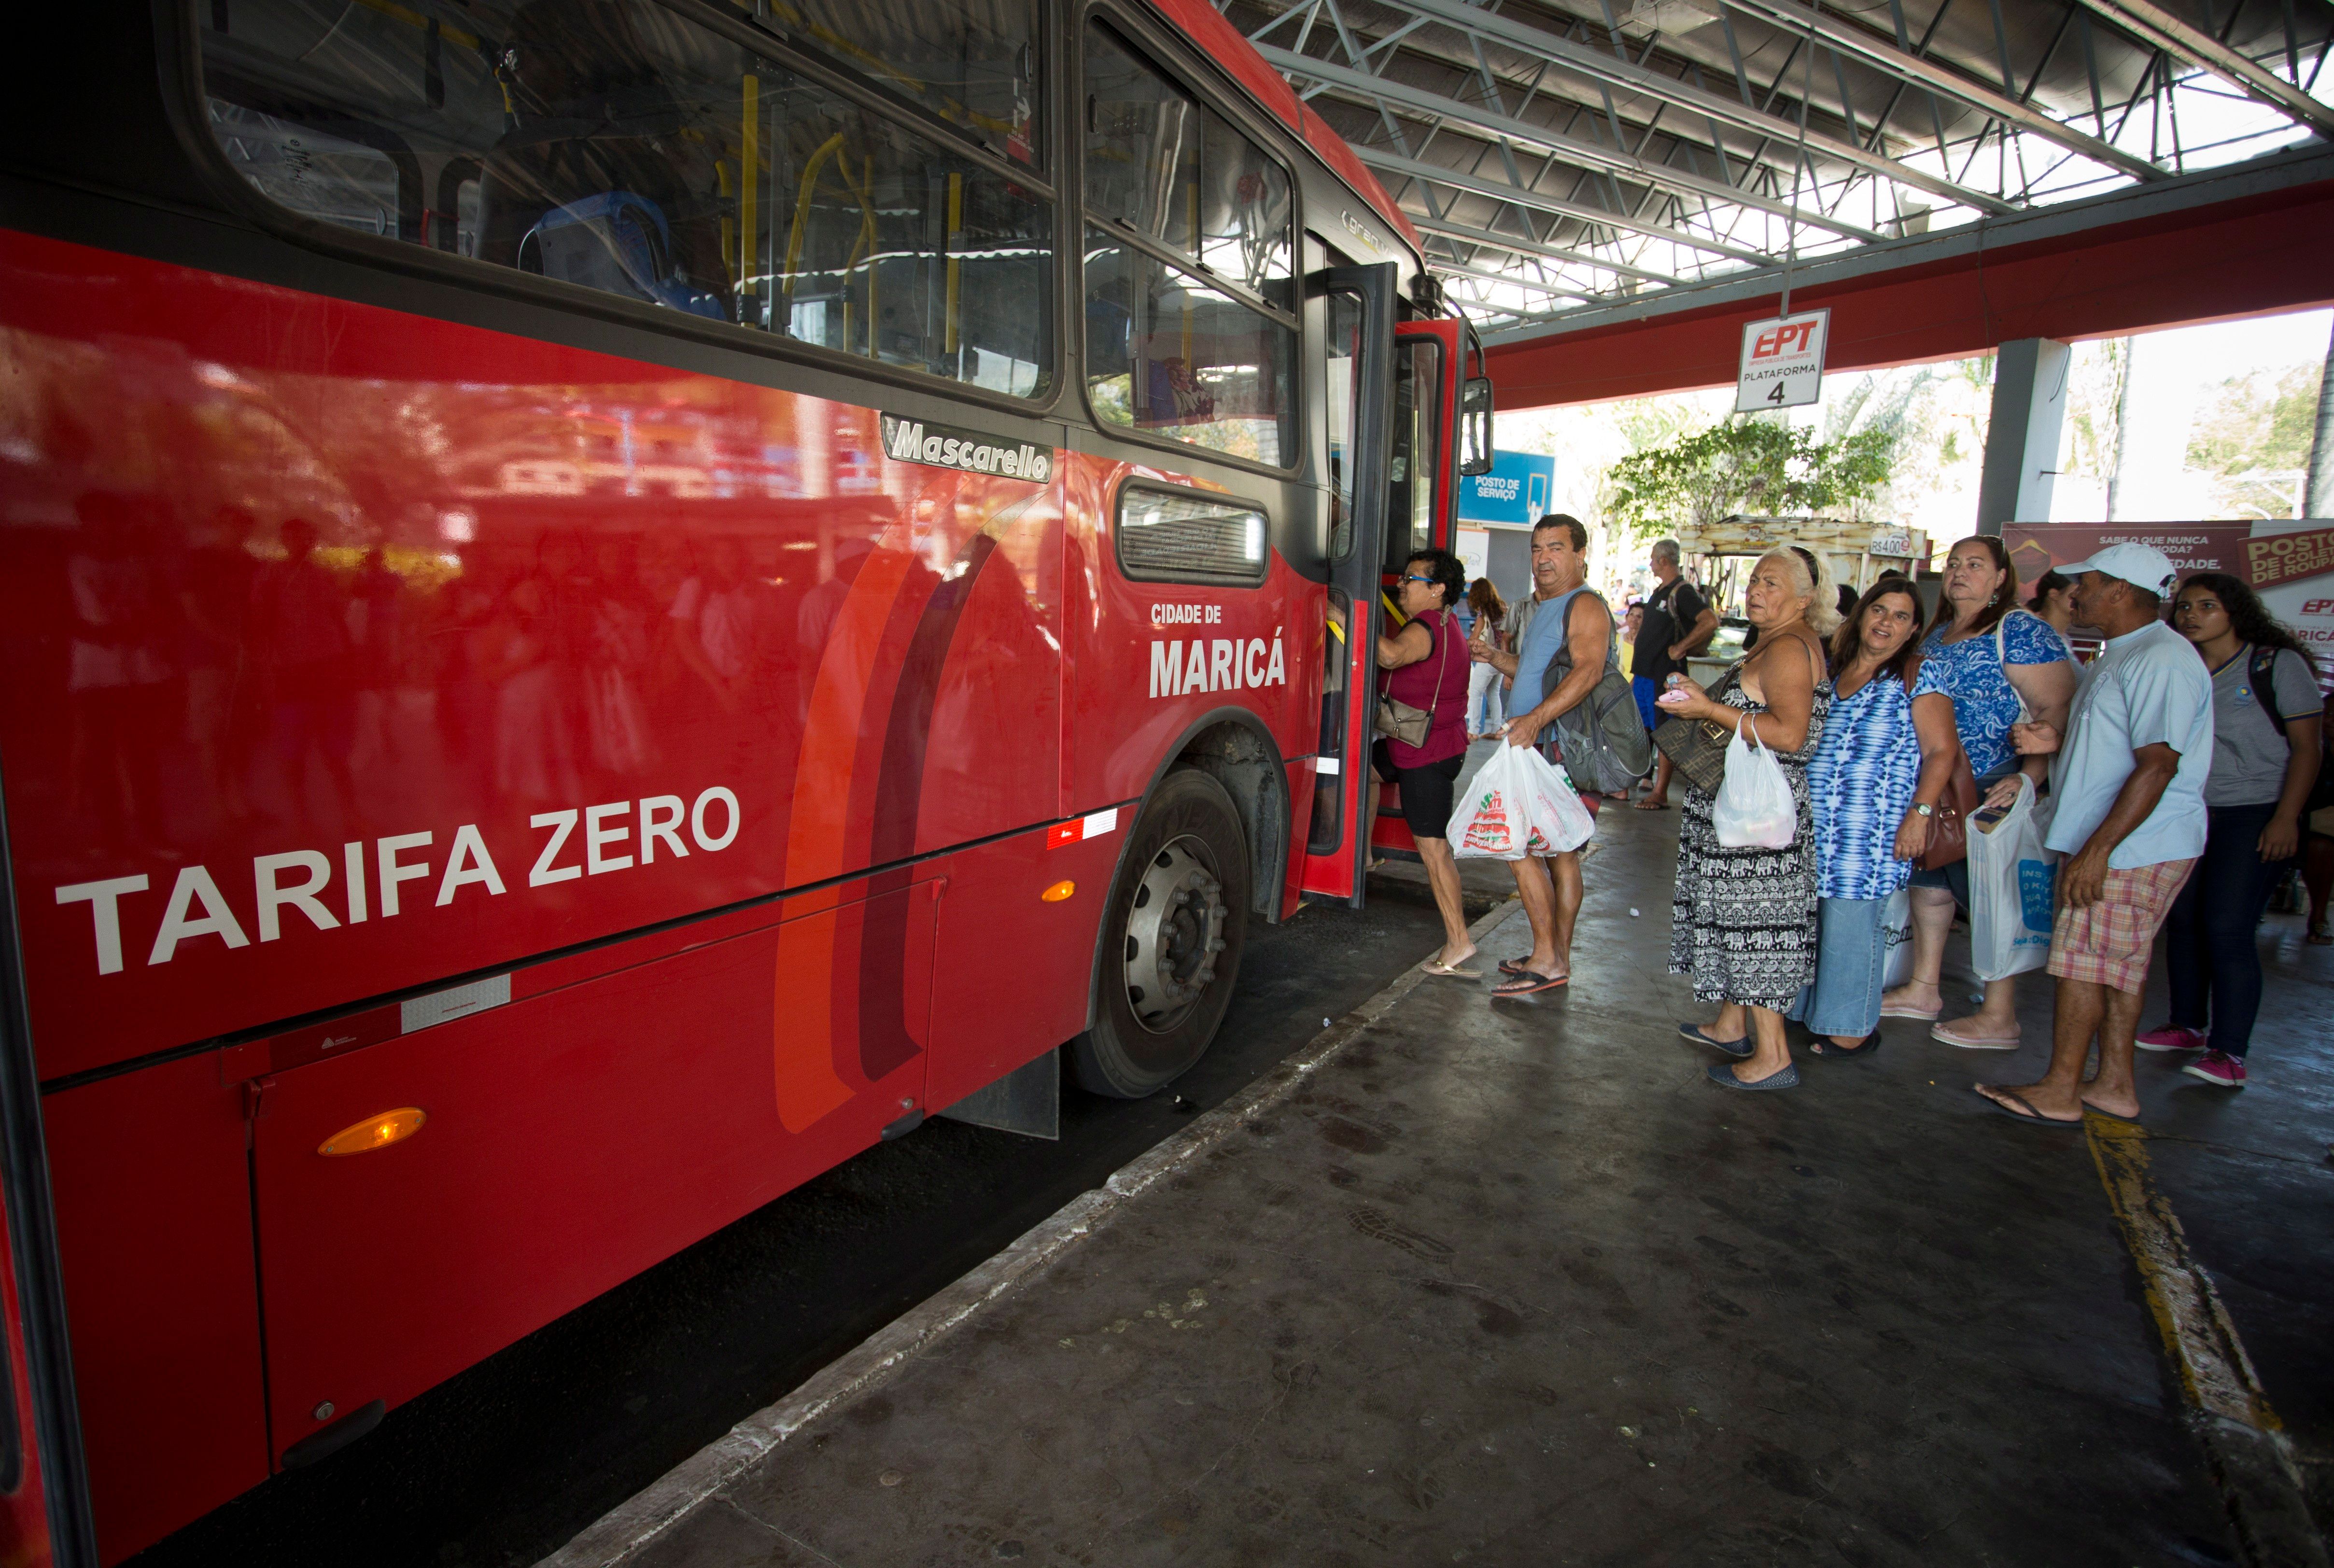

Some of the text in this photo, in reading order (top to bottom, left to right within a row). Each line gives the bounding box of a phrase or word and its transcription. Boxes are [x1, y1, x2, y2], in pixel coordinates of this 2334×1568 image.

[1752, 321, 1818, 359] EPT
[1744, 364, 1816, 381] PLATAFORMA
[1767, 381, 1785, 404] 4
[892, 420, 1048, 479] Mascarello
[1475, 476, 1519, 490] POSTO DE
[1477, 486, 1516, 501] SERVIÇO
[2140, 536, 2164, 545] QUE
[2166, 536, 2208, 545] NUNCA
[2251, 557, 2281, 572] DE
[2252, 568, 2280, 584] DE
[1151, 604, 1221, 624] CIDADE DE
[1149, 627, 1286, 698] MARICÁ
[55, 785, 741, 976] TARIFA ZERO
